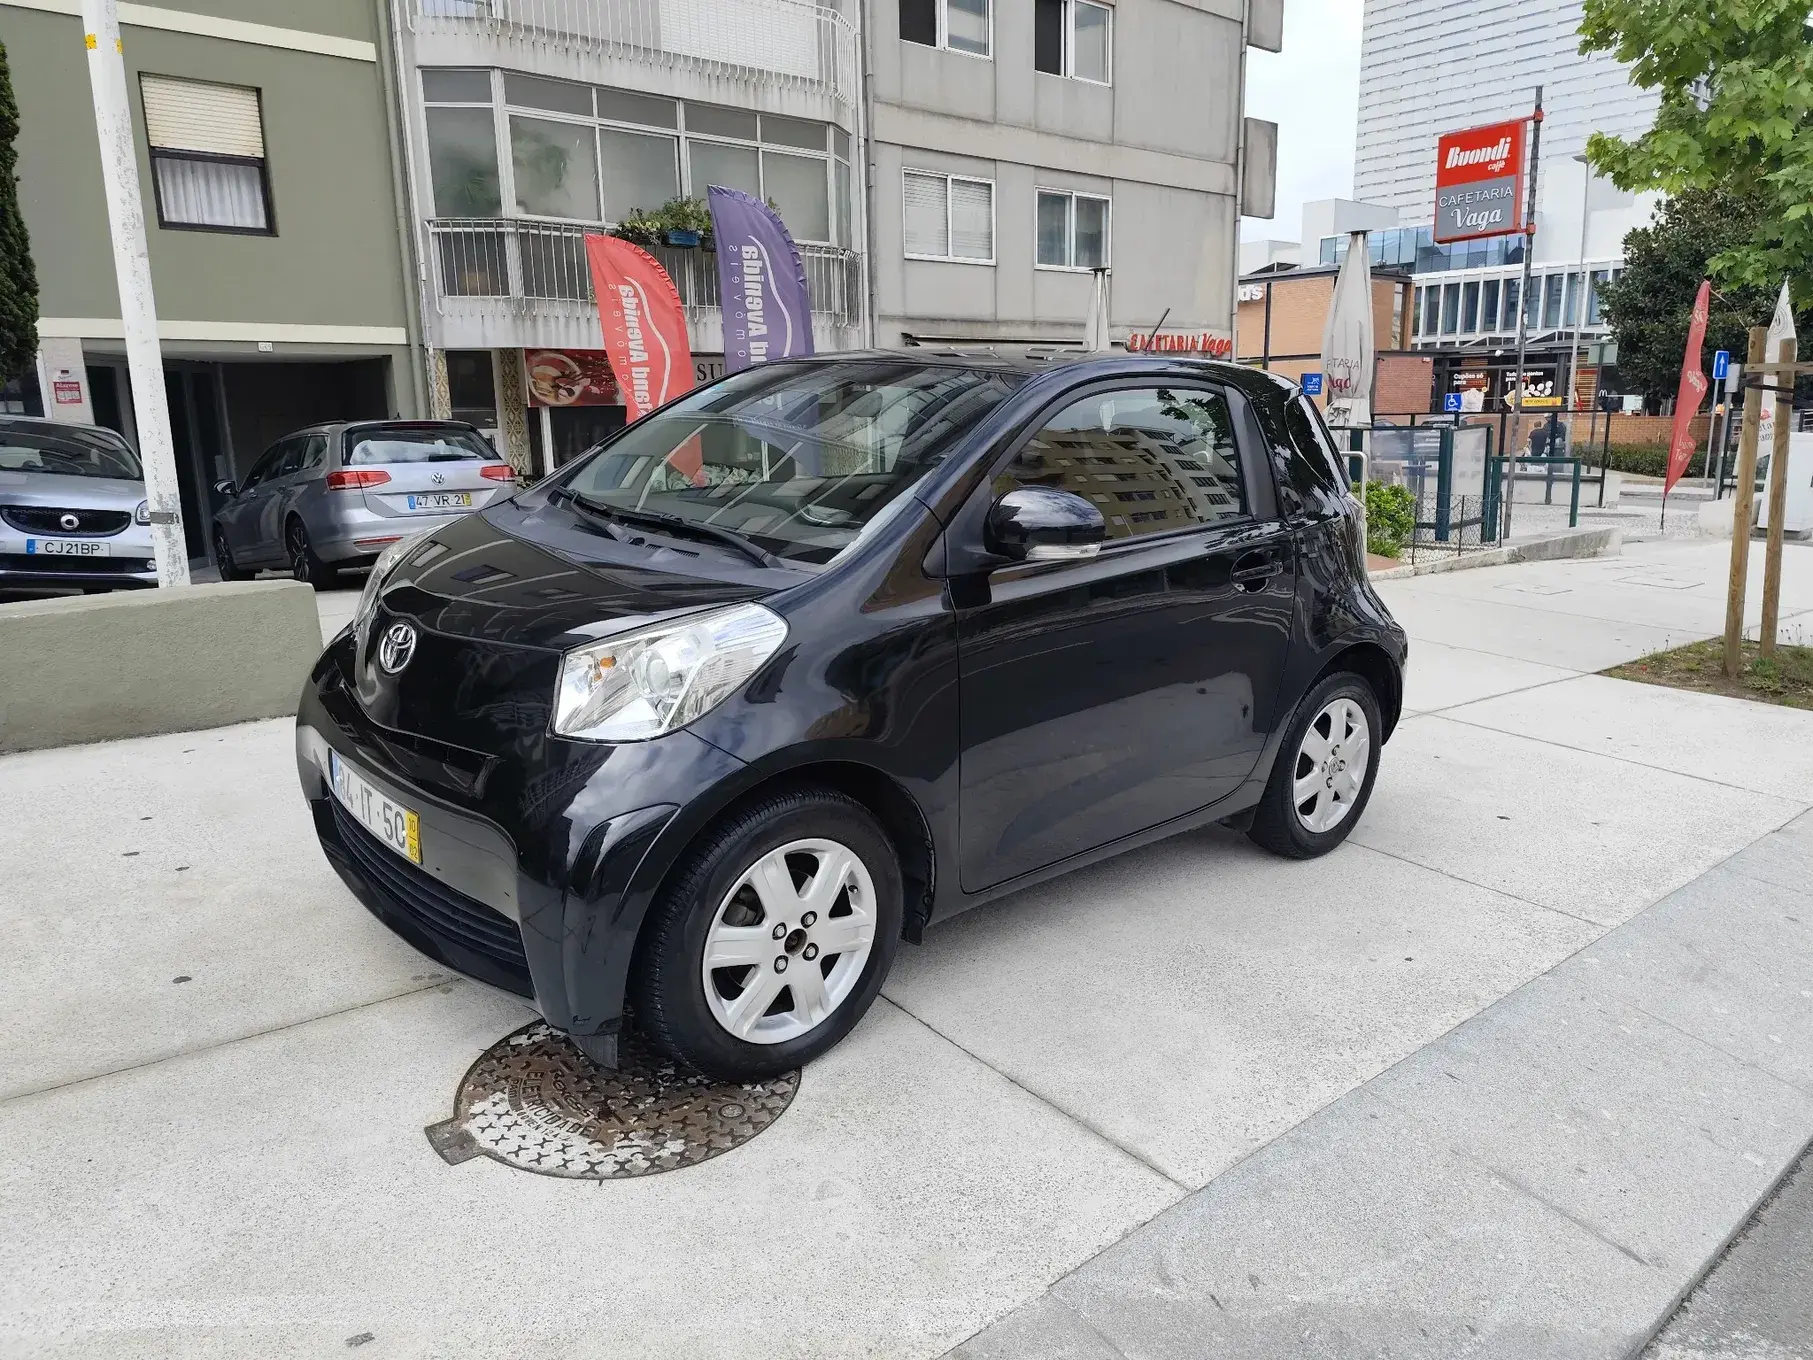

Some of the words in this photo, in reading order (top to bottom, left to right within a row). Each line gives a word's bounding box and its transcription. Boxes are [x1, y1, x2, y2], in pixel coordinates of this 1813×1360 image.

[1445, 136, 1511, 169] Buondi
[1439, 186, 1514, 207] CAFETARIA
[1450, 207, 1503, 232] Vaga
